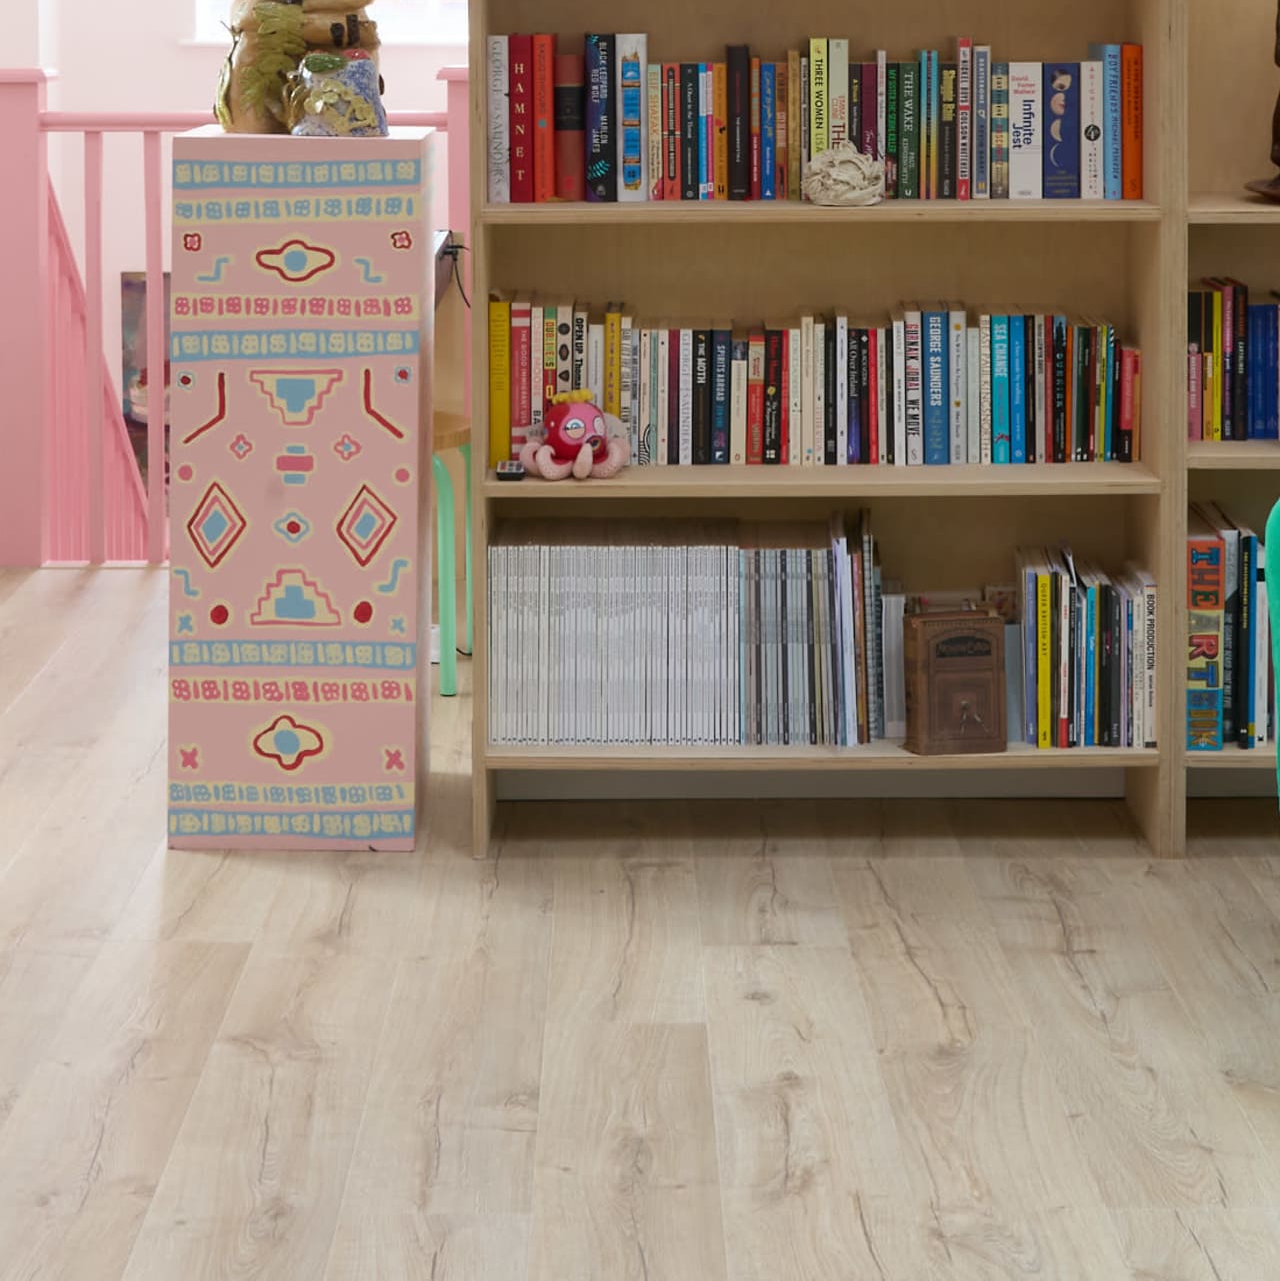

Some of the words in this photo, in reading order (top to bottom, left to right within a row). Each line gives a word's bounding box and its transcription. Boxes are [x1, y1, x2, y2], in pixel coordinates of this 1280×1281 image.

[815, 59, 823, 86] THREE
[904, 72, 913, 95] THE
[515, 63, 525, 181] HAMNET
[815, 91, 823, 129] WOMEN
[904, 99, 913, 131] WAKE
[1023, 99, 1033, 144] Infinite
[960, 112, 968, 139] COLSON
[1012, 123, 1023, 149] Jest
[960, 141, 968, 178] WHITEHEAD
[576, 318, 584, 337] OPEN
[930, 317, 940, 354] GEORGE
[995, 324, 1005, 341] SEA
[576, 341, 584, 354] UP
[849, 339, 858, 350] All
[697, 358, 705, 383] MOTH
[849, 353, 857, 370] Over
[995, 343, 1005, 377] CHANGE
[849, 373, 858, 397] Ireland
[930, 357, 941, 406] SAUNDERS
[907, 399, 918, 410] WE
[907, 413, 919, 436] MOVE
[1192, 548, 1220, 607] THE
[1147, 594, 1155, 617] BOOK
[1147, 619, 1155, 669] PRODUCTION
[1190, 693, 1218, 748] BOOK
